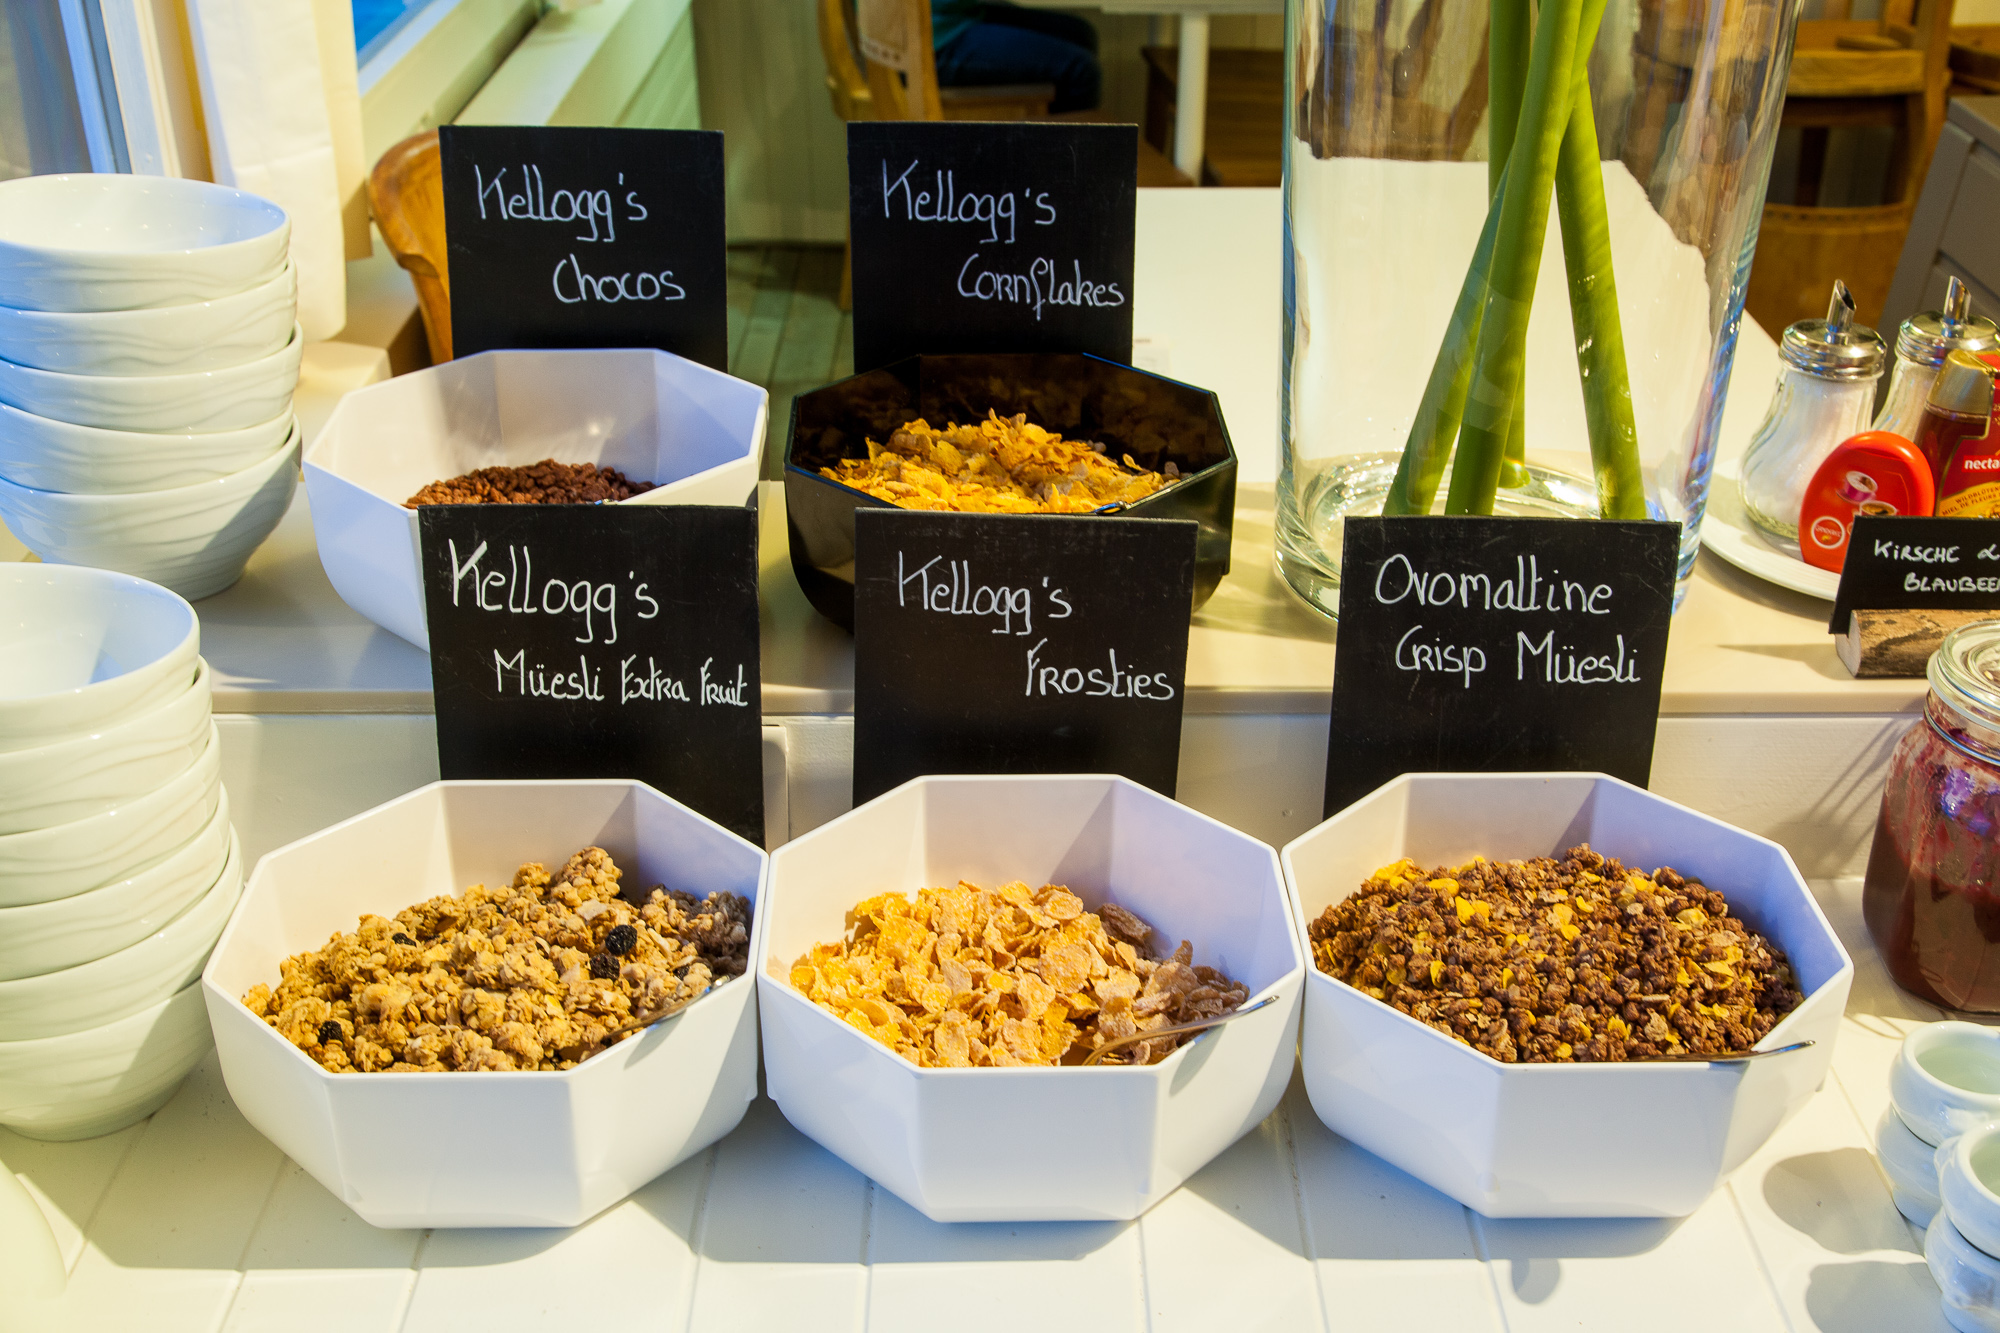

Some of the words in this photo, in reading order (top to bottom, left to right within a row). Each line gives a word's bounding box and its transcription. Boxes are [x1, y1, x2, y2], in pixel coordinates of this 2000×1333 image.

[474, 164, 648, 243] Kellogg's
[883, 159, 1056, 243] Kellogg's
[552, 253, 686, 304] Chocos
[957, 253, 1125, 321] Cornflakes
[1964, 458, 2000, 470] necta
[448, 538, 659, 645] Kellogg's
[898, 550, 1073, 636] Kellogg's
[1374, 553, 1613, 615] Ovomaltine
[1904, 571, 2000, 593] BLAUBEE
[493, 648, 605, 702] Müesli
[621, 653, 691, 705] Extra
[699, 656, 749, 707] Fruit
[1025, 637, 1175, 701] Frosties
[1395, 624, 1487, 689] Crisp
[1516, 629, 1641, 685] Müesli
